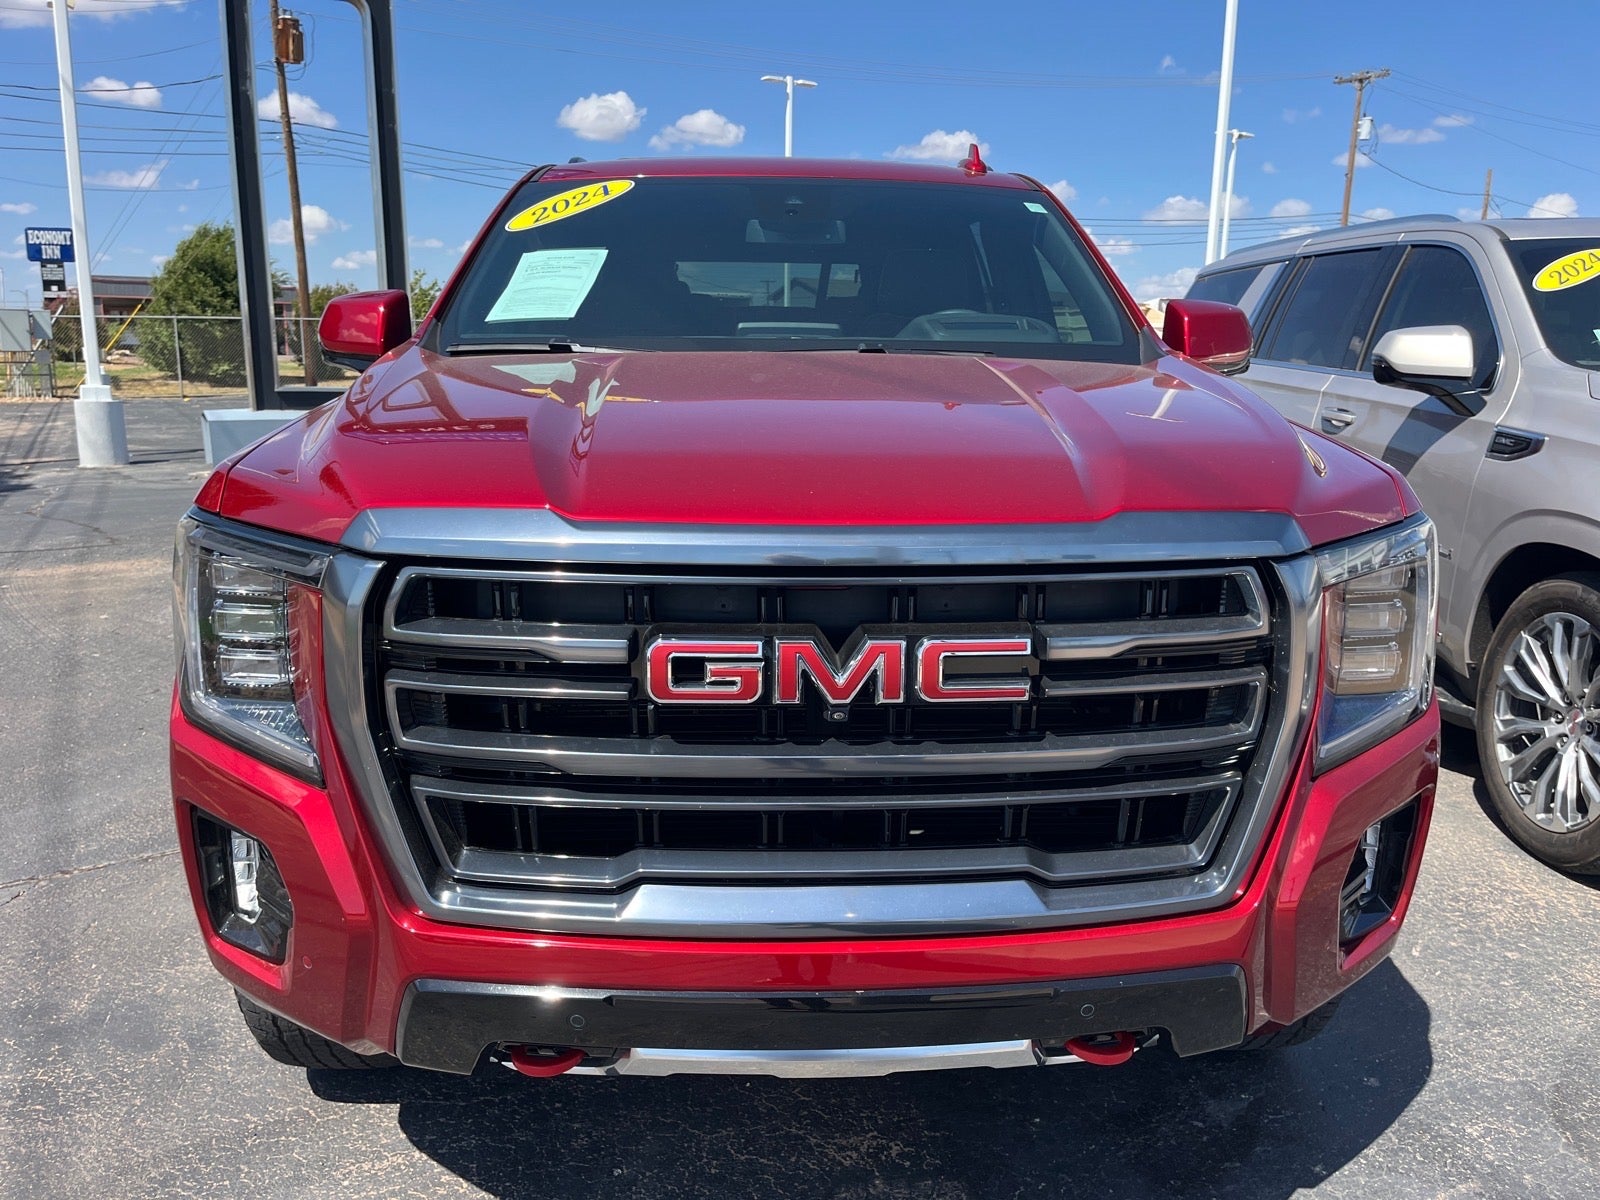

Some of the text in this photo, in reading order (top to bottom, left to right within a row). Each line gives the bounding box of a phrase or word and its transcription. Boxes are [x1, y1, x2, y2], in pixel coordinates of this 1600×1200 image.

[531, 183, 613, 224] 2024
[27, 229, 72, 245] ECONOMY
[41, 245, 61, 259] INN
[646, 633, 1032, 704] GMC
